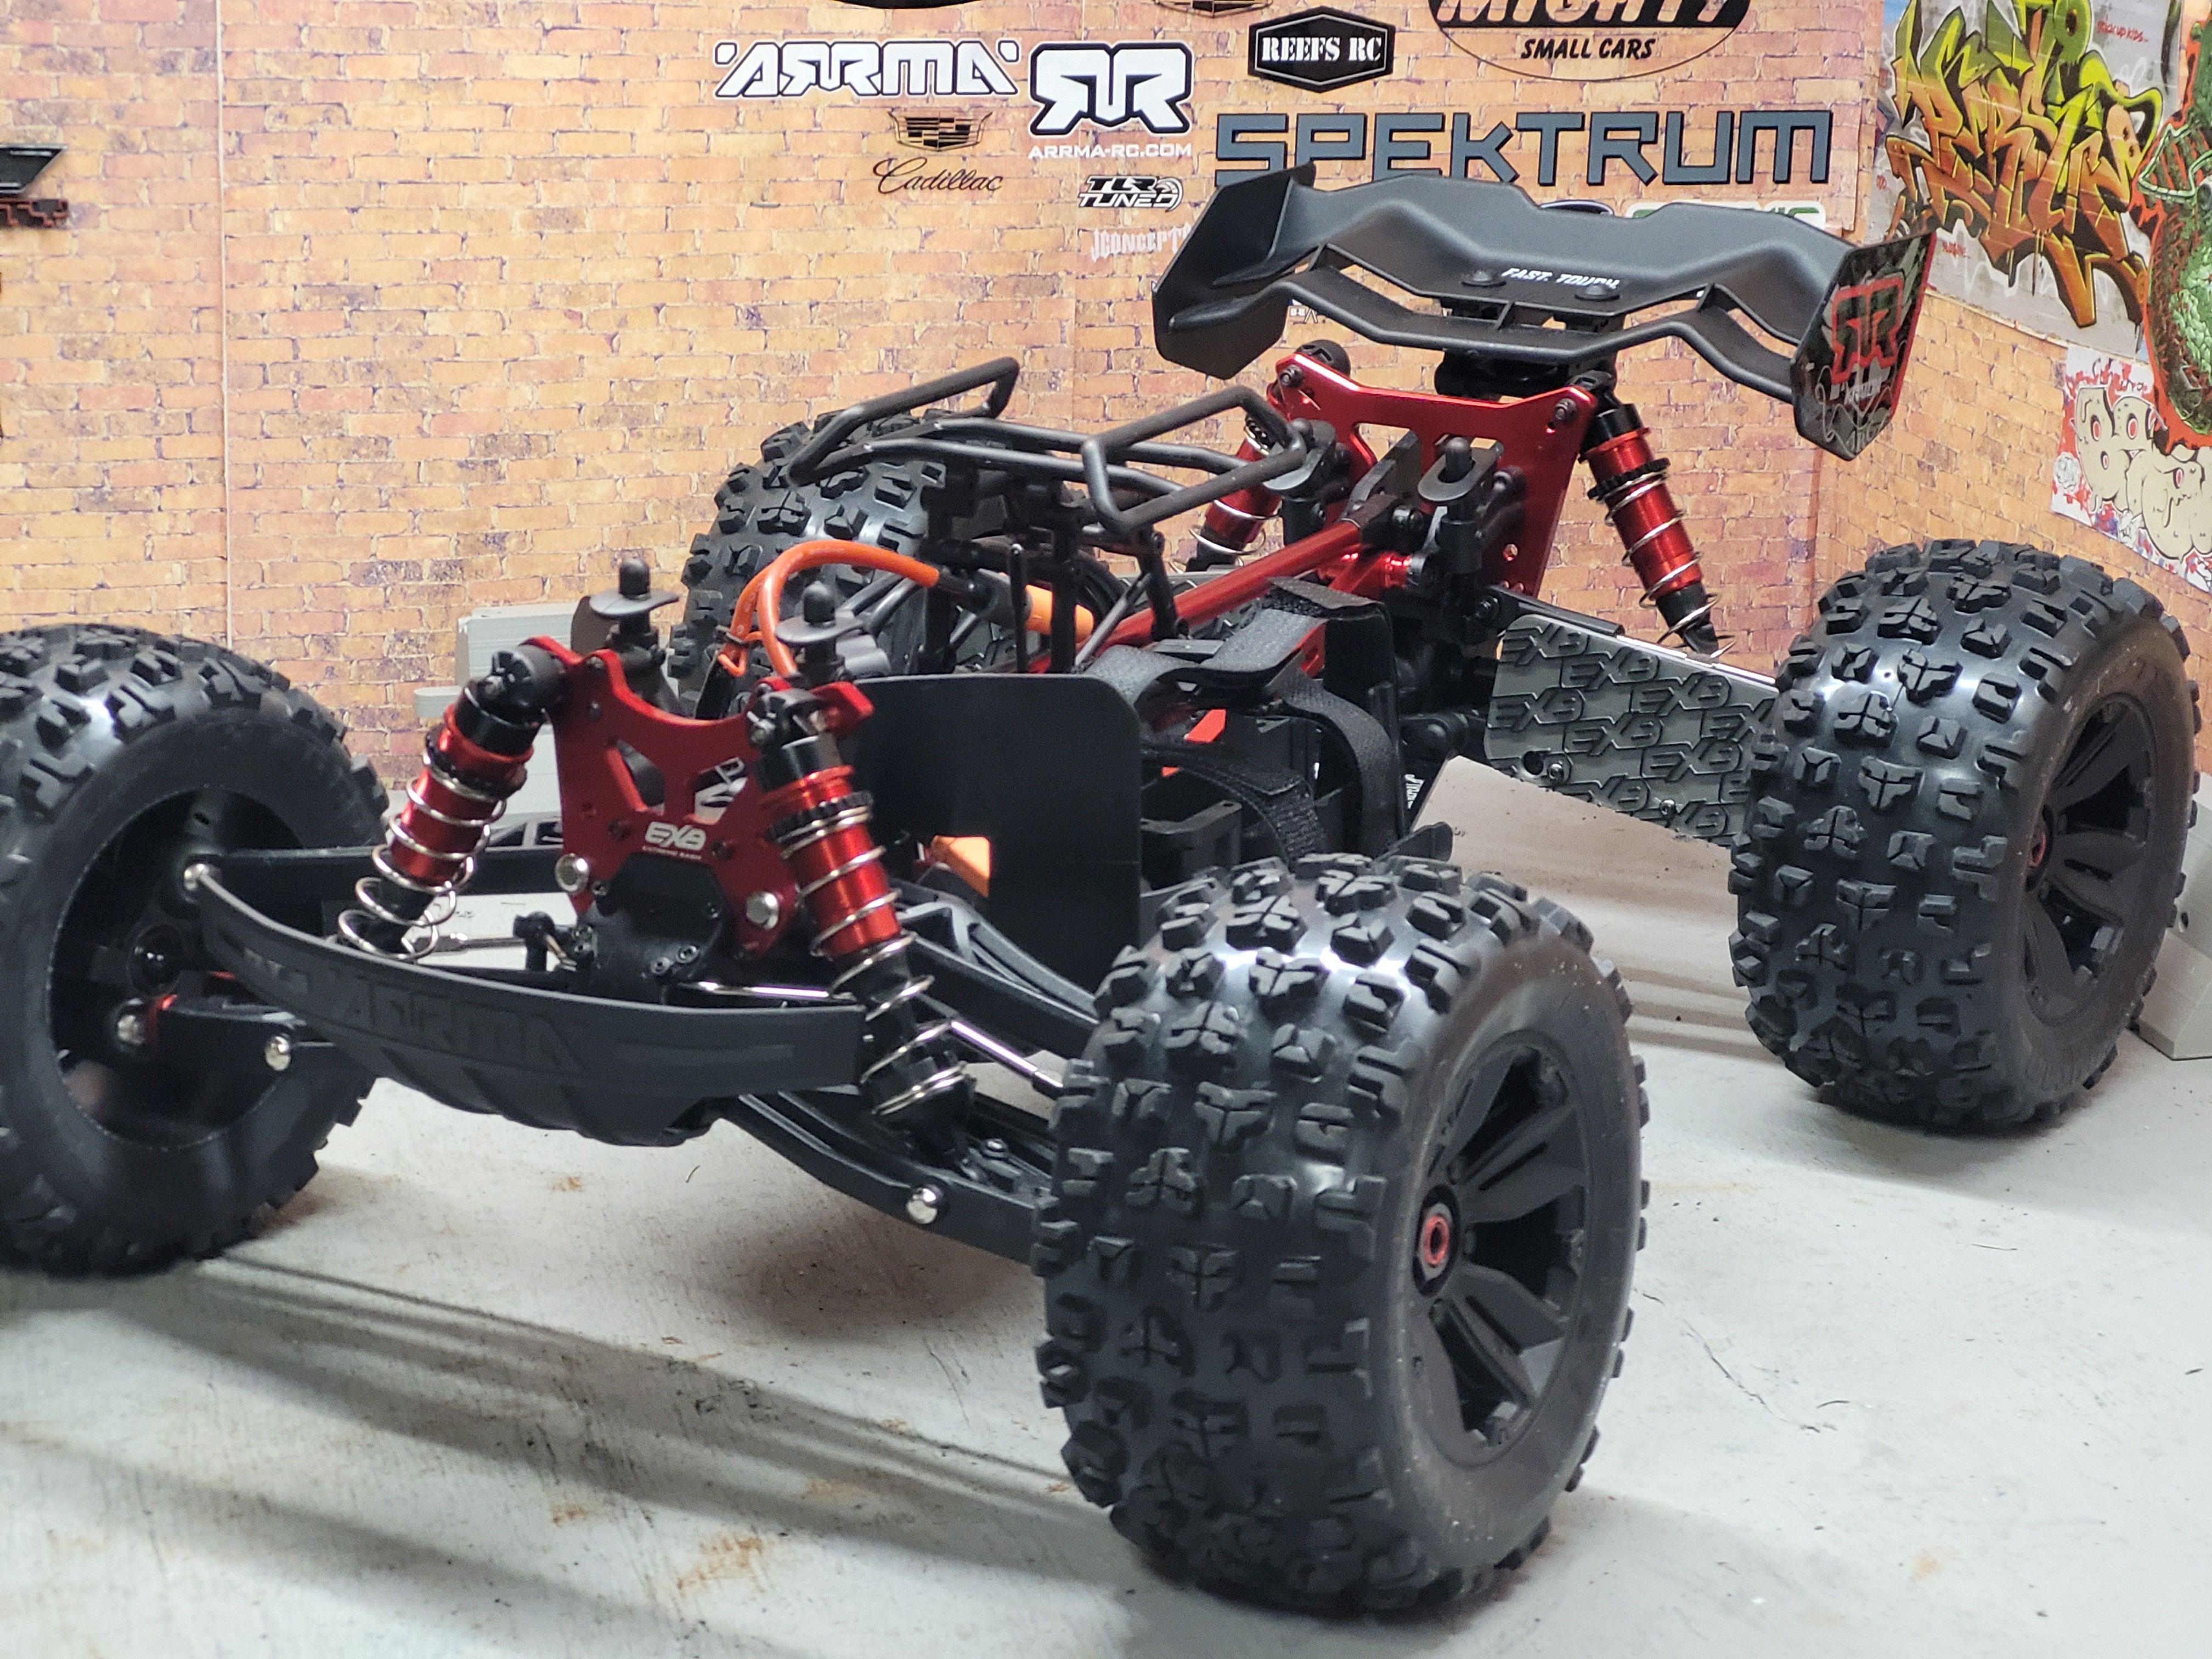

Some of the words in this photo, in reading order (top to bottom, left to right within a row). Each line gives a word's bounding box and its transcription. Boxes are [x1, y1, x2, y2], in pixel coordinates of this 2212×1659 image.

[1262, 37, 1340, 61] REEFS
[1348, 37, 1381, 61] RC
[1521, 38, 1591, 59] SMALL
[1599, 38, 1656, 59] CARS
[1028, 144, 1192, 159] ARRMA-RC.COM
[1215, 111, 1833, 188] SPEKTRUM
[872, 157, 1003, 194] Cadillac
[1086, 176, 1159, 192] TLR
[1078, 193, 1180, 208] TUNED
